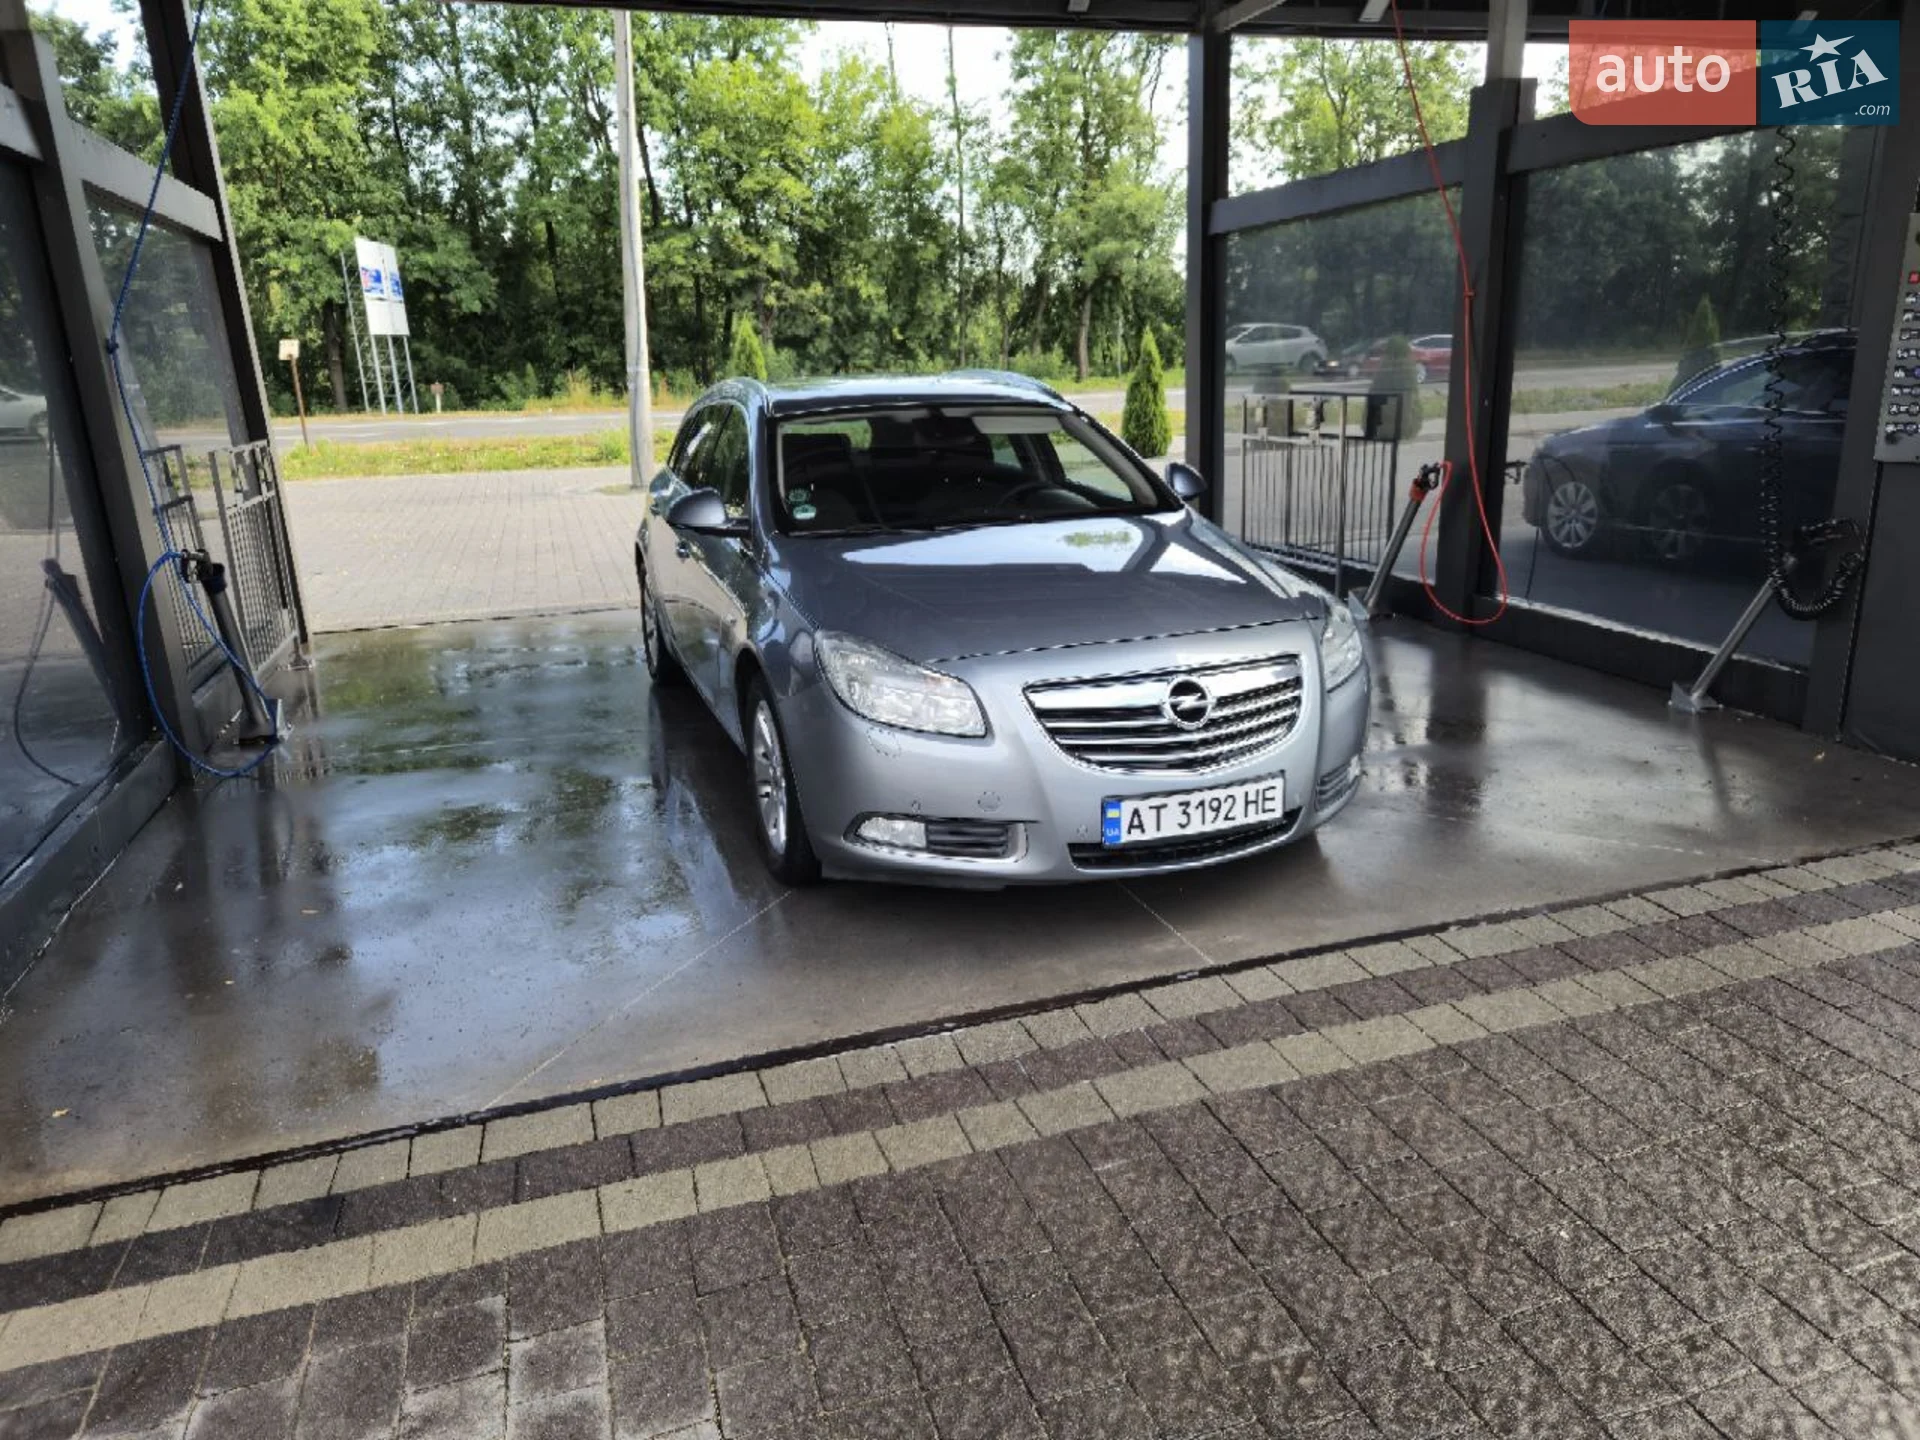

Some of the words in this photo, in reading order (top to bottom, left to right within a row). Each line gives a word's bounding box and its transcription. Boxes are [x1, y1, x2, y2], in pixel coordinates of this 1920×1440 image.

[1127, 803, 1168, 835] AT
[1177, 795, 1237, 829] 3192
[1244, 786, 1277, 818] HE
[1106, 828, 1120, 837] UA
